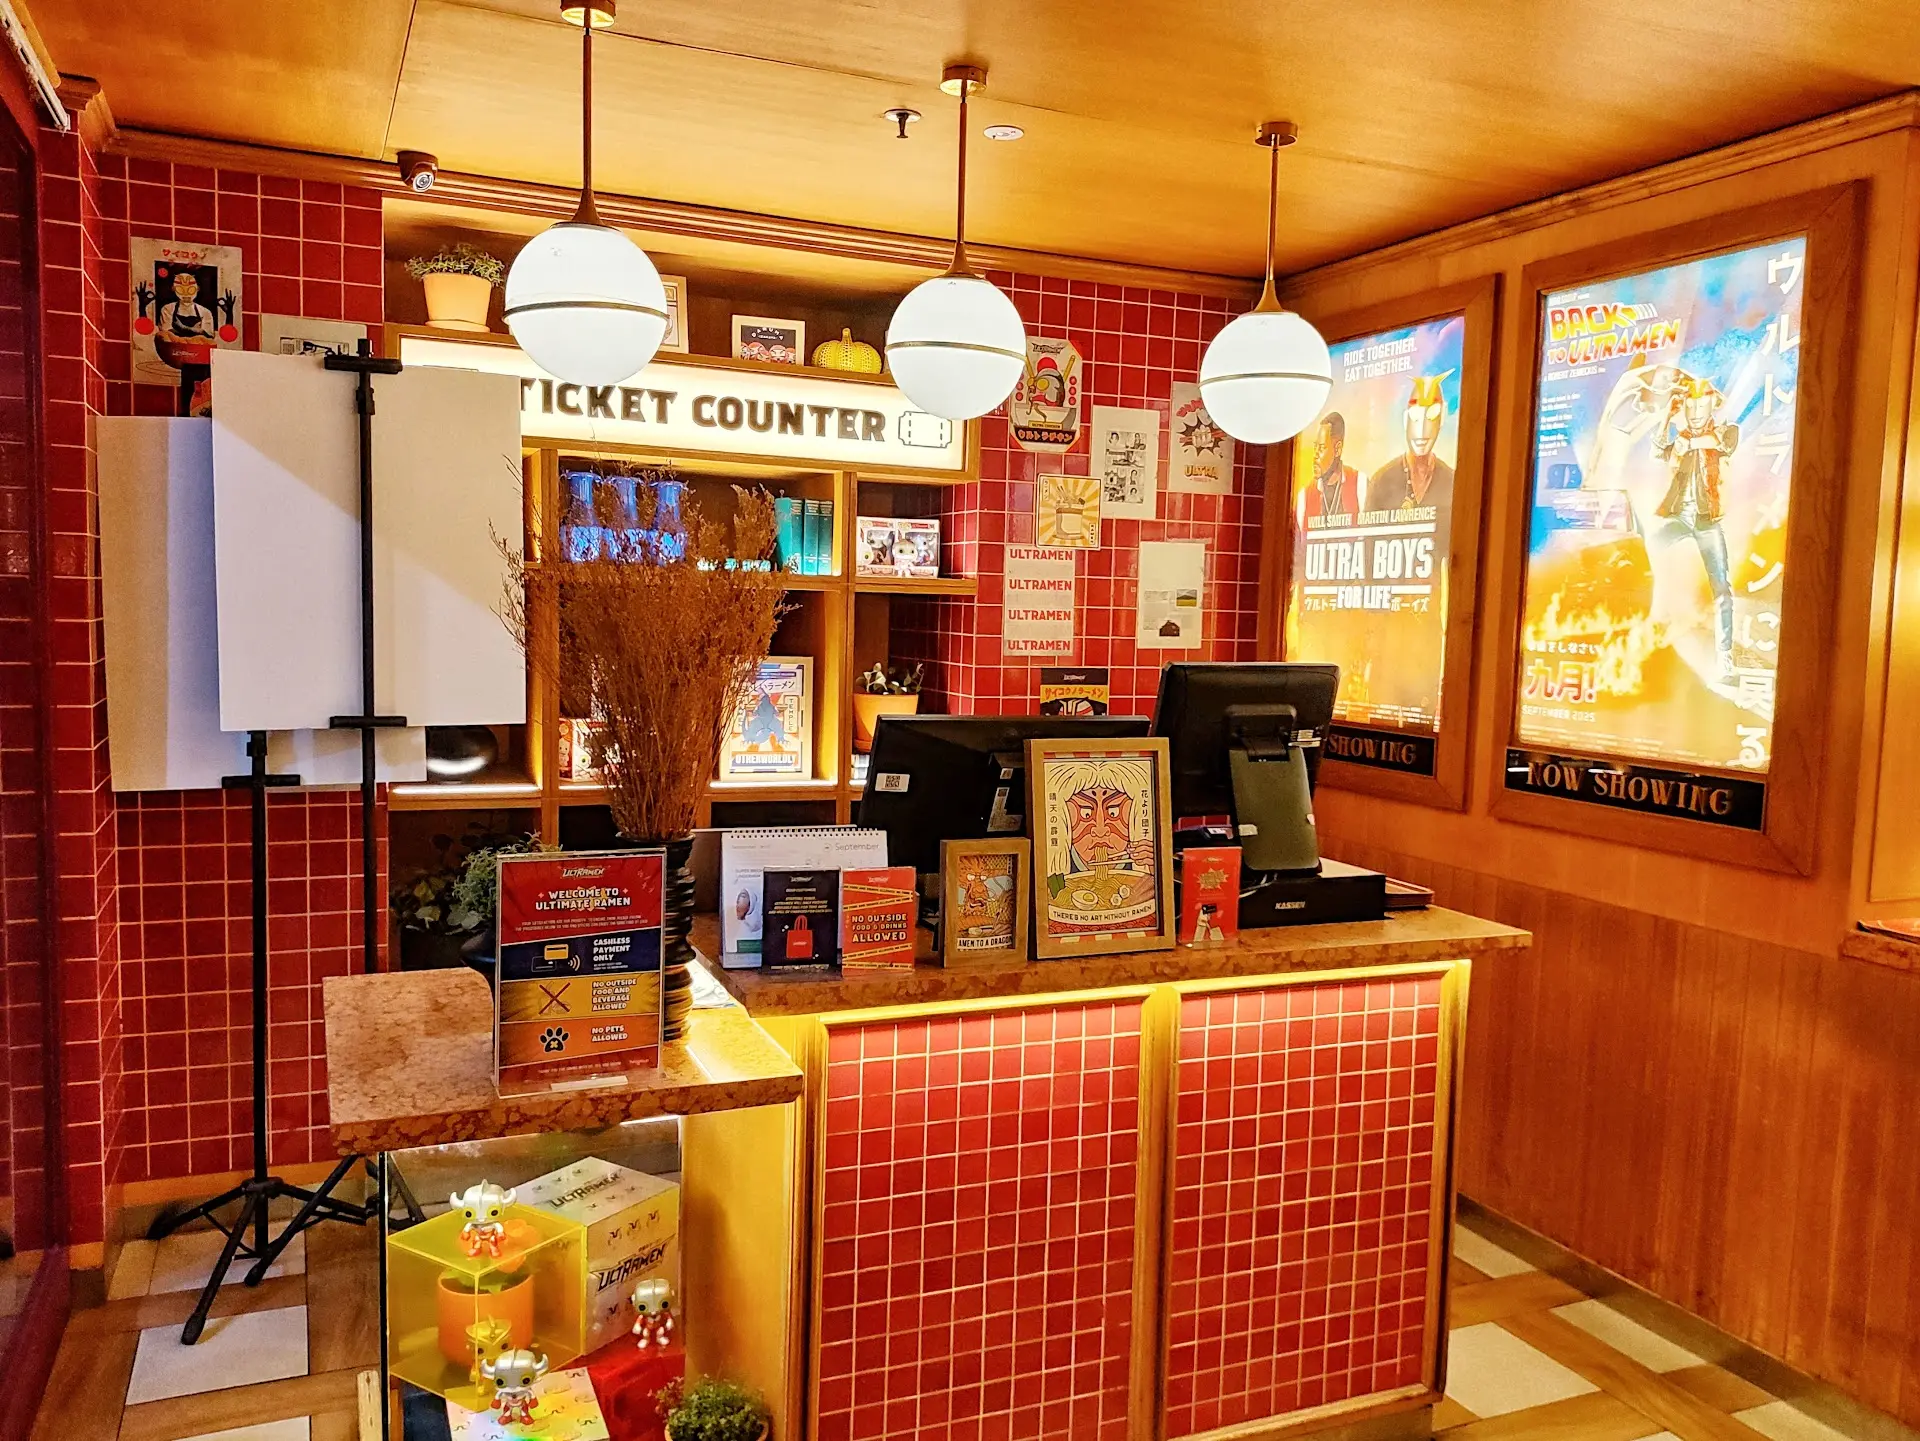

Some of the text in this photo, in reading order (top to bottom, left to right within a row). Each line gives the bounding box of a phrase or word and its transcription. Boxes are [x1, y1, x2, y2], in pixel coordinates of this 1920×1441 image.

[1549, 304, 1637, 342] BACK
[1547, 319, 1682, 367] TO ULTRAMEN
[1343, 337, 1418, 367] RIDE TOGETHER.
[1344, 355, 1413, 383] EAT TOGETHER.
[691, 394, 886, 442] COUNTER
[1307, 506, 1436, 528] WILL SMITH MARTIN LAWRENCE
[1010, 549, 1073, 560] ULTRAMEN
[1304, 537, 1434, 580] ULTRA BOYS
[1009, 579, 1072, 590] ULTRAMEN
[1304, 597, 1337, 611] ウルトラ
[1337, 586, 1392, 609] FOR LIFE
[1391, 597, 1430, 612] ボーイズ
[1008, 610, 1071, 621] ULTRAMEN
[1007, 639, 1071, 651] ULTRAMEN
[1521, 704, 1570, 719] SEPTEMBER
[1328, 734, 1416, 765] SHOWING
[1526, 762, 1733, 815] NOW SHOWING
[1140, 790, 1149, 838] 花より団子
[835, 843, 880, 852] September
[548, 887, 619, 900] WELCOME TO
[535, 897, 631, 911] ULTIMATE RAMEN
[851, 914, 907, 924] NO OUTSIDE
[1103, 911, 1130, 921] WITHOUT
[1131, 905, 1152, 916] RAMEN
[879, 922, 907, 930] DRINKS
[593, 937, 631, 946] CASHLESS
[852, 931, 907, 943] ALLOWED
[976, 939, 984, 947] TO
[592, 945, 631, 954] PAYMENT
[592, 953, 614, 962] ONLY
[592, 978, 637, 988] NO OUTSIDE
[592, 987, 630, 996] FOOD AND
[592, 995, 630, 1004] BEVERAGE
[592, 1002, 627, 1012] ALLOWED
[591, 1025, 624, 1034] NO PETS
[591, 1033, 628, 1042] ALLOWED
[550, 1173, 620, 1207] ULTRAMEN
[598, 1243, 666, 1291] ULTRAMEN
